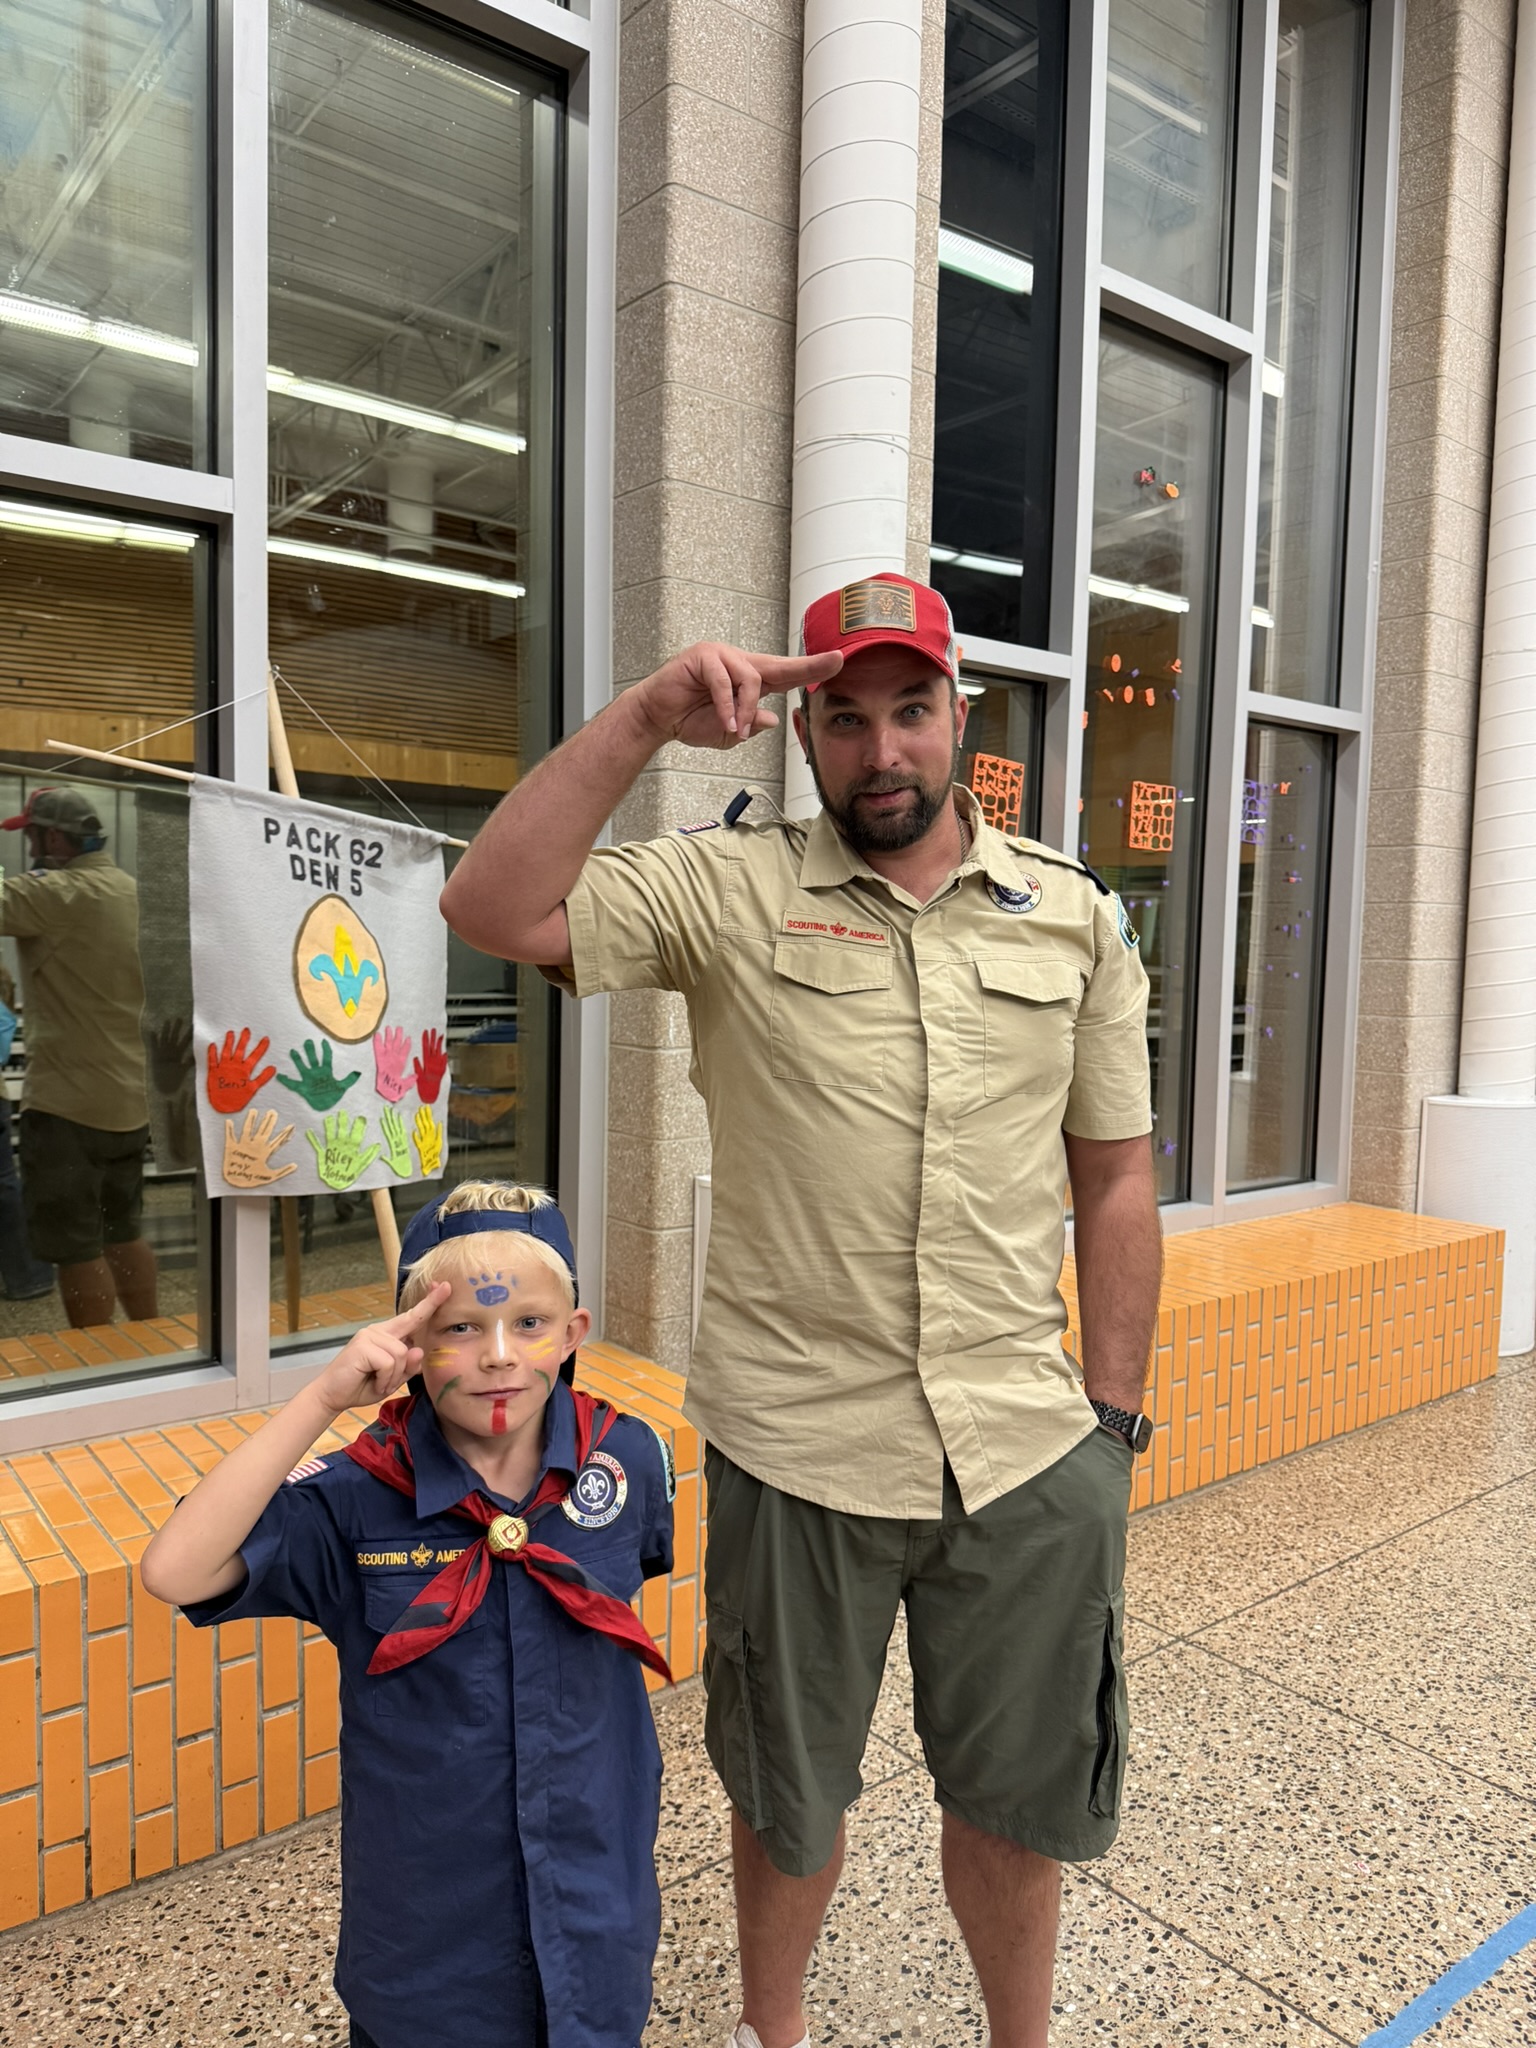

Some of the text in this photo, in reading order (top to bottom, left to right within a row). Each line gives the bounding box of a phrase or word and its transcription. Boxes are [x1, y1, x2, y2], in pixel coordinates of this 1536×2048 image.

[264, 818, 383, 869] PACK 62
[290, 853, 363, 896] DEN 5
[787, 920, 886, 942] SCOUTING AMERICA
[325, 1147, 353, 1172] Riley
[592, 1453, 622, 1477] AMERICA
[584, 1506, 618, 1526] SINCE 1910
[357, 1551, 408, 1565] SCOUTING
